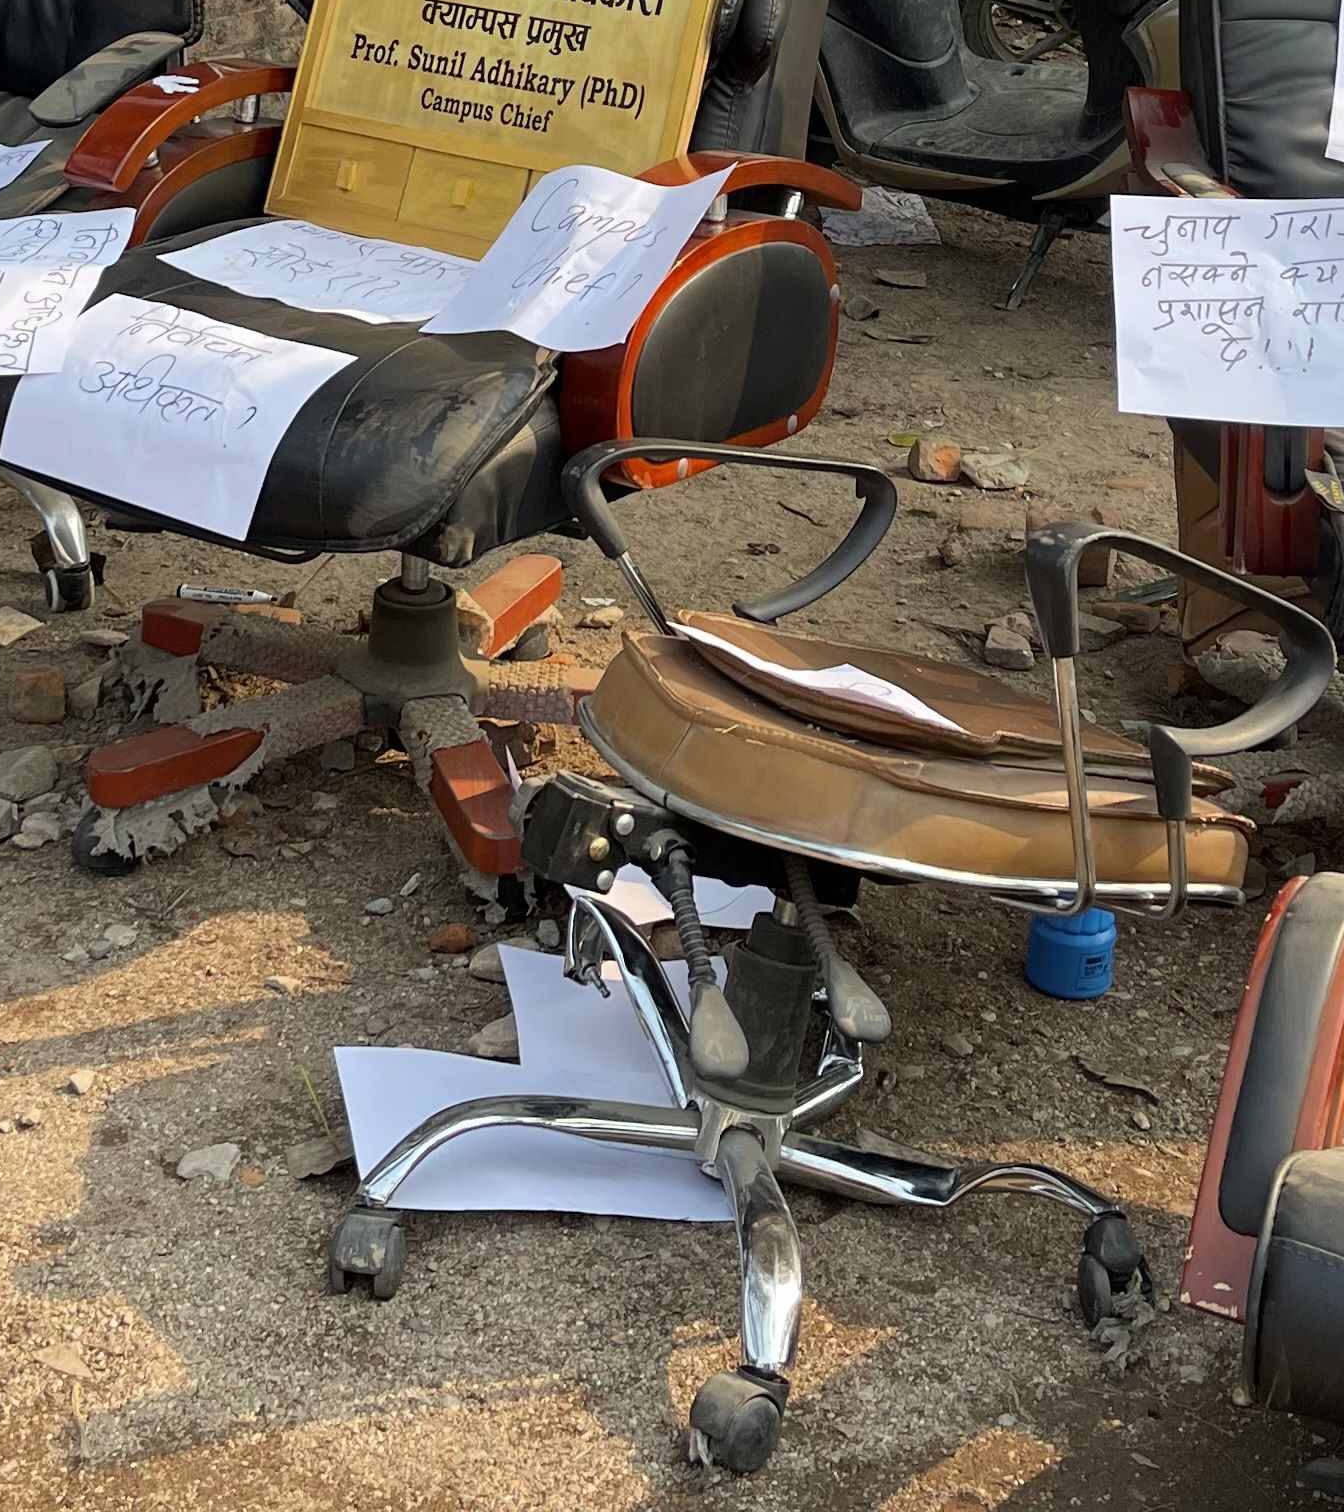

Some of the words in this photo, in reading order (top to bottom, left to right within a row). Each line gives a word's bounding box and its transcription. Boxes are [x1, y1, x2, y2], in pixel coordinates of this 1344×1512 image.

[525, 14, 592, 57] प्रमुख
[349, 32, 400, 68] Prof.
[406, 43, 468, 80] Sunil
[468, 55, 577, 108] Adhikary
[580, 74, 646, 121] (PhD)
[420, 87, 496, 125] Campus
[499, 101, 555, 134] Chief
[530, 177, 669, 253] Campus
